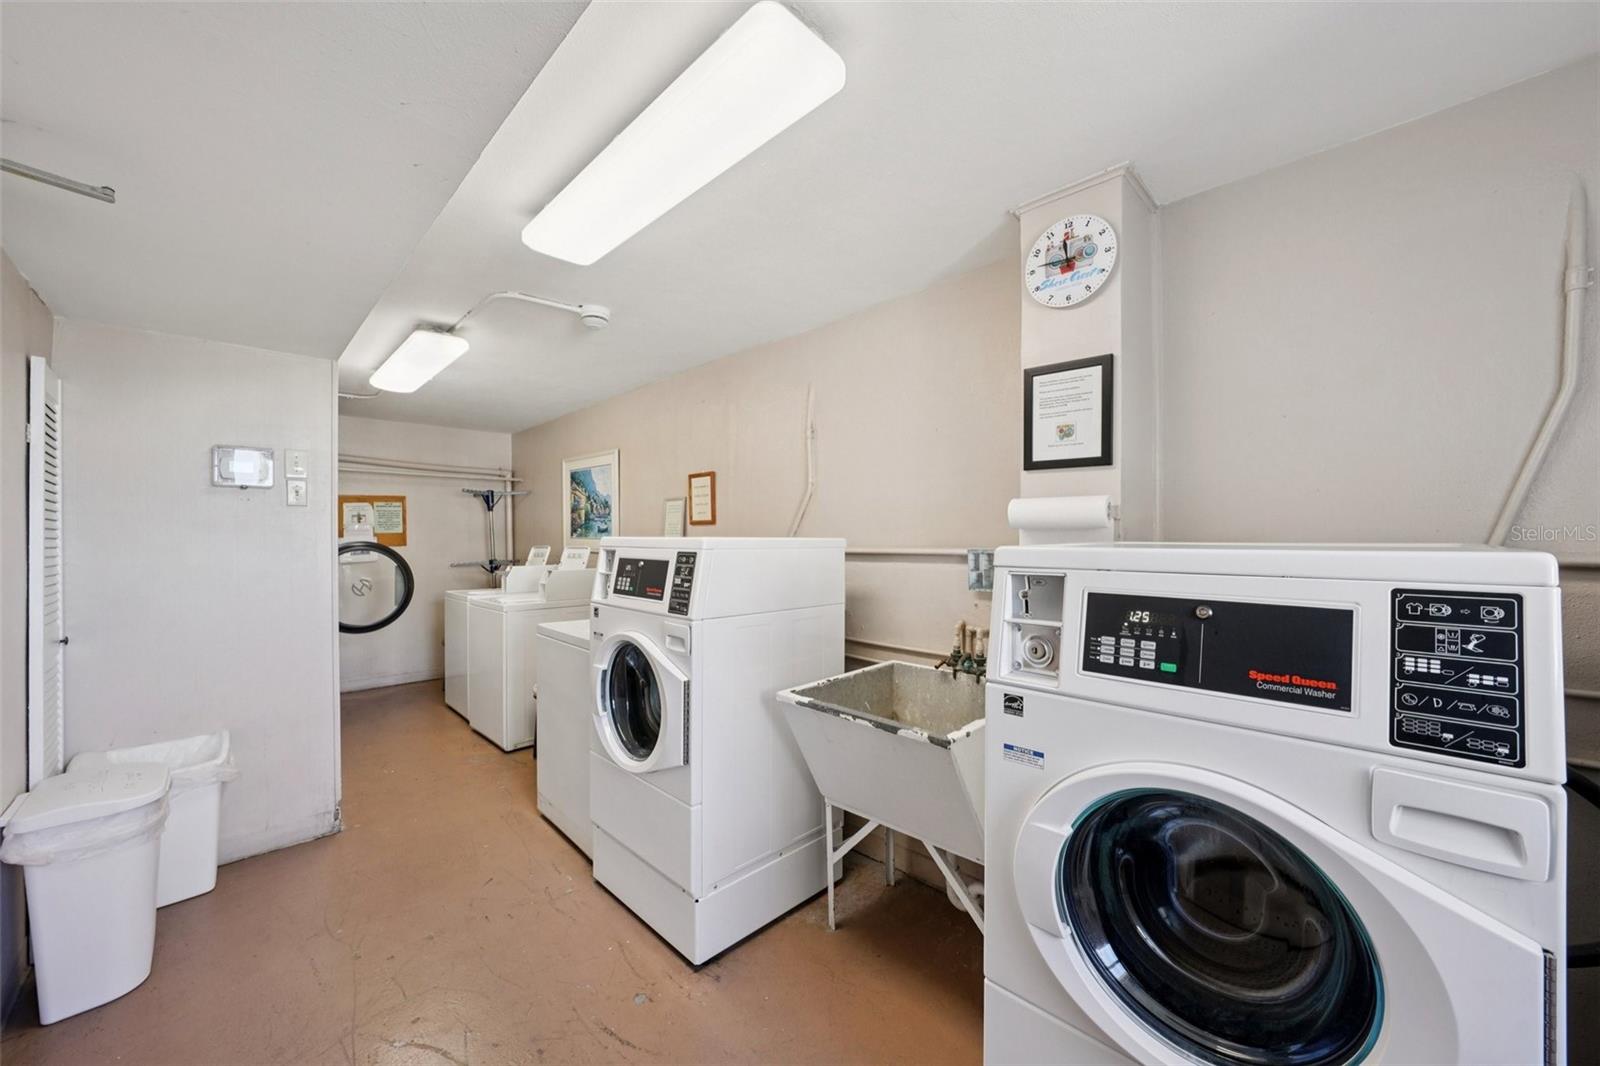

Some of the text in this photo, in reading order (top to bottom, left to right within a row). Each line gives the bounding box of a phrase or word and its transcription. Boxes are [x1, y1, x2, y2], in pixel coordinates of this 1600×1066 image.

[1064, 221, 1073, 229] 12
[1046, 232, 1055, 240] 11
[1033, 249, 1041, 258] 10
[1248, 670, 1337, 690] Speed Queen
[1256, 681, 1336, 699] Commercial Washer
